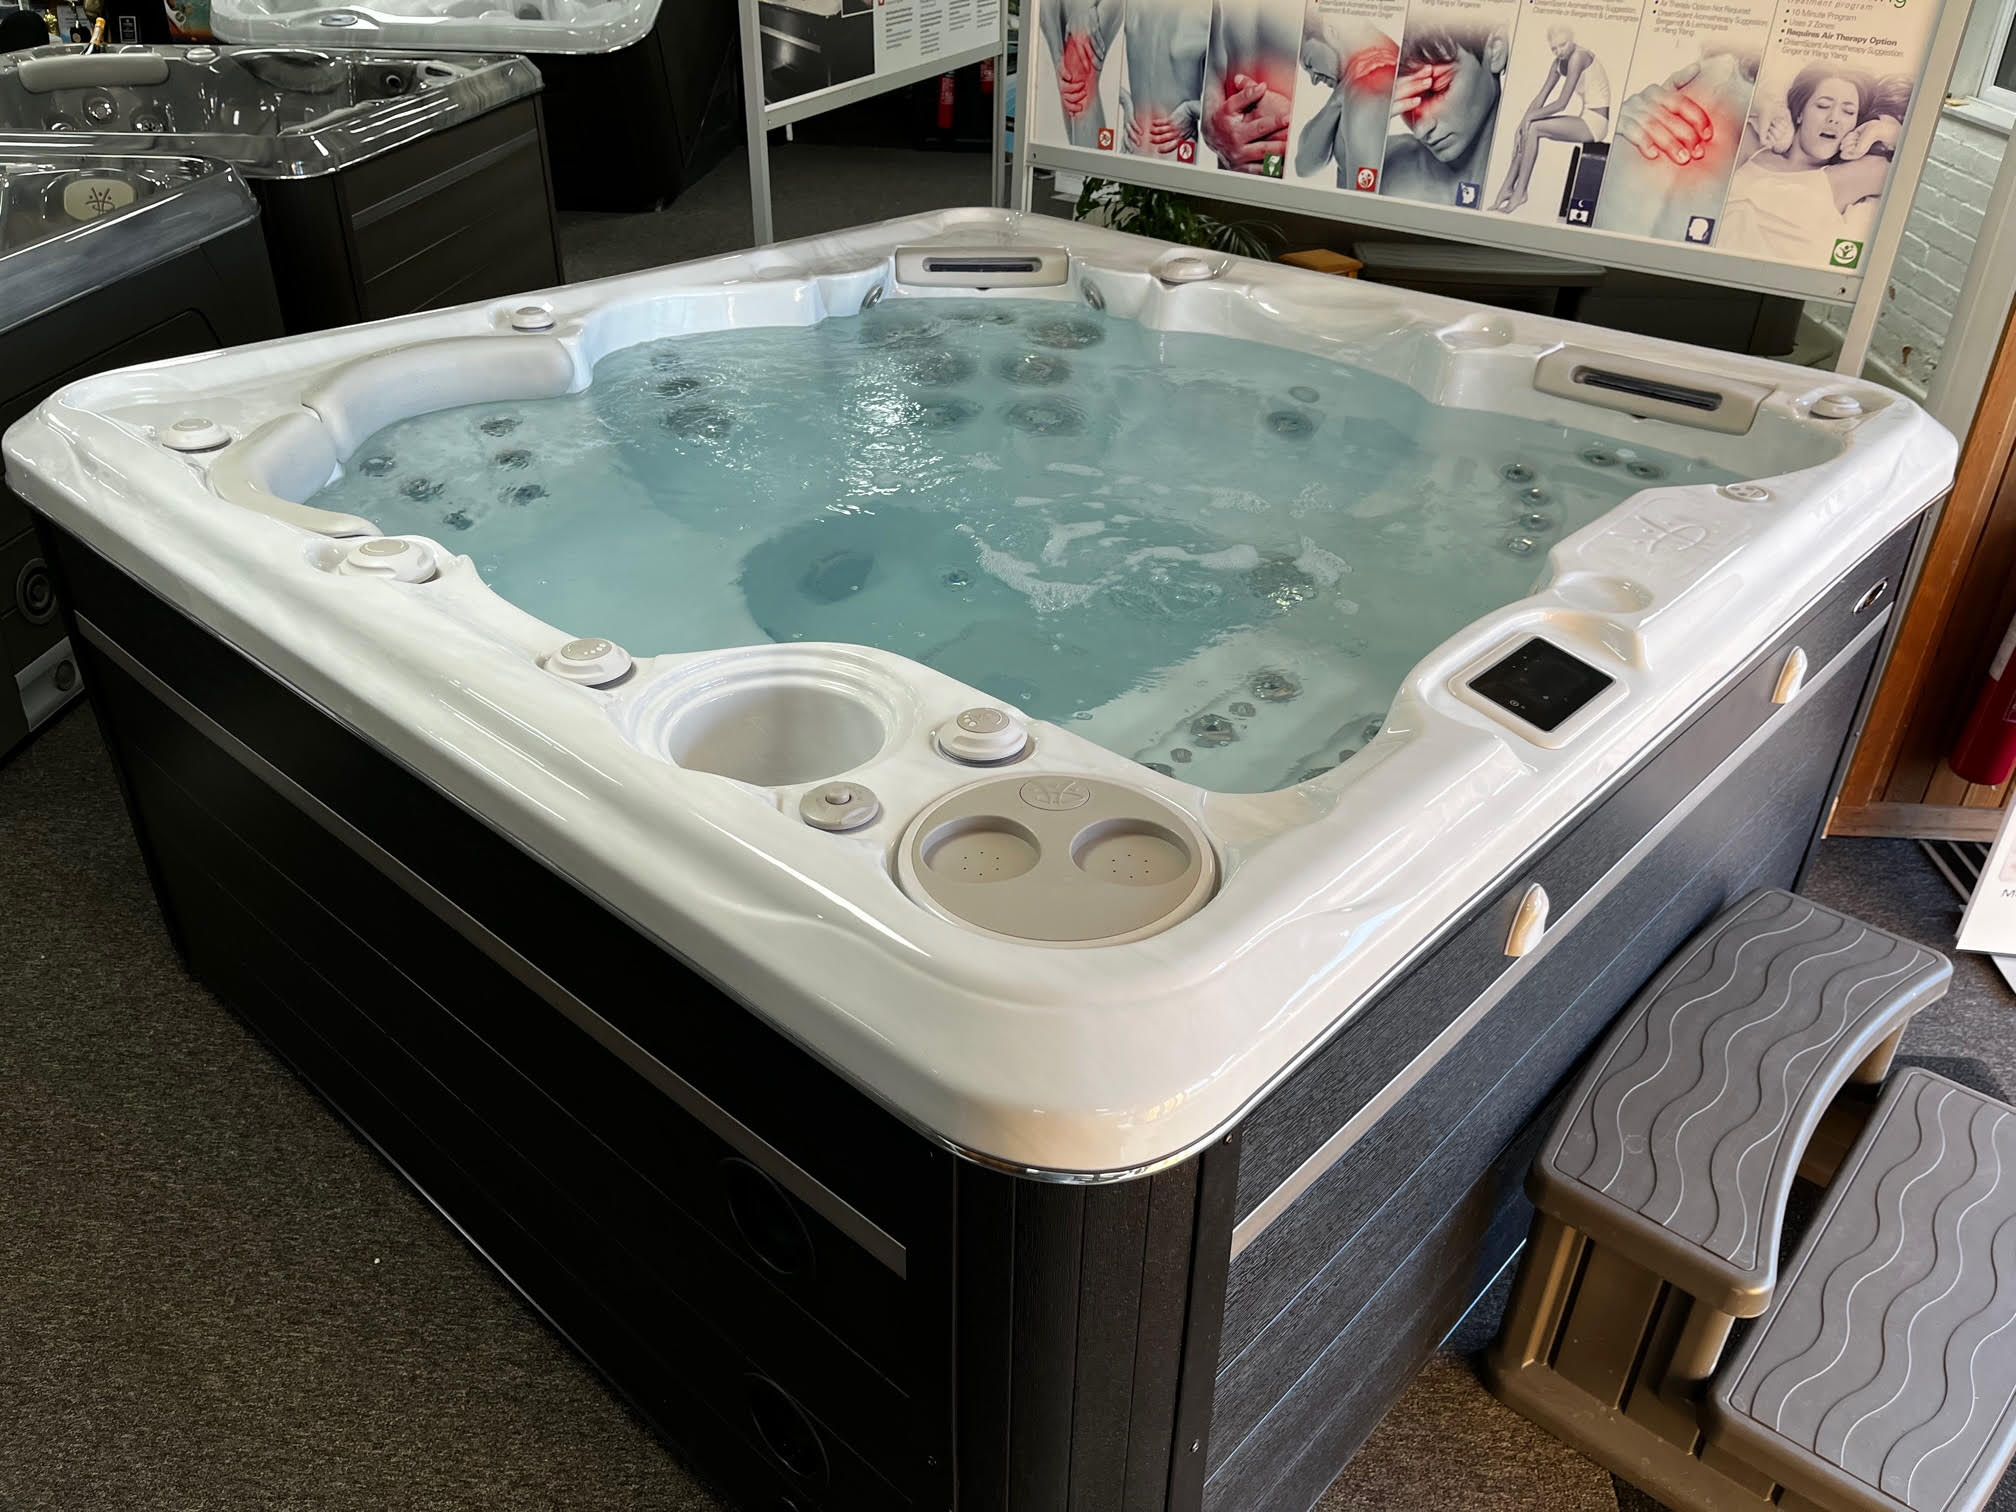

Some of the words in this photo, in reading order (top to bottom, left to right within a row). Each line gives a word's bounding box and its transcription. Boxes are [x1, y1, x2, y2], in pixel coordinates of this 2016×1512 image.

[1802, 9, 1825, 18] Minute
[1827, 12, 1857, 21] Program
[1814, 21, 1835, 30] Zones
[1786, 28, 1820, 39] Requires
[1821, 32, 1834, 40] Air
[1836, 33, 1868, 44] Therapy
[1869, 36, 1898, 47] Option
